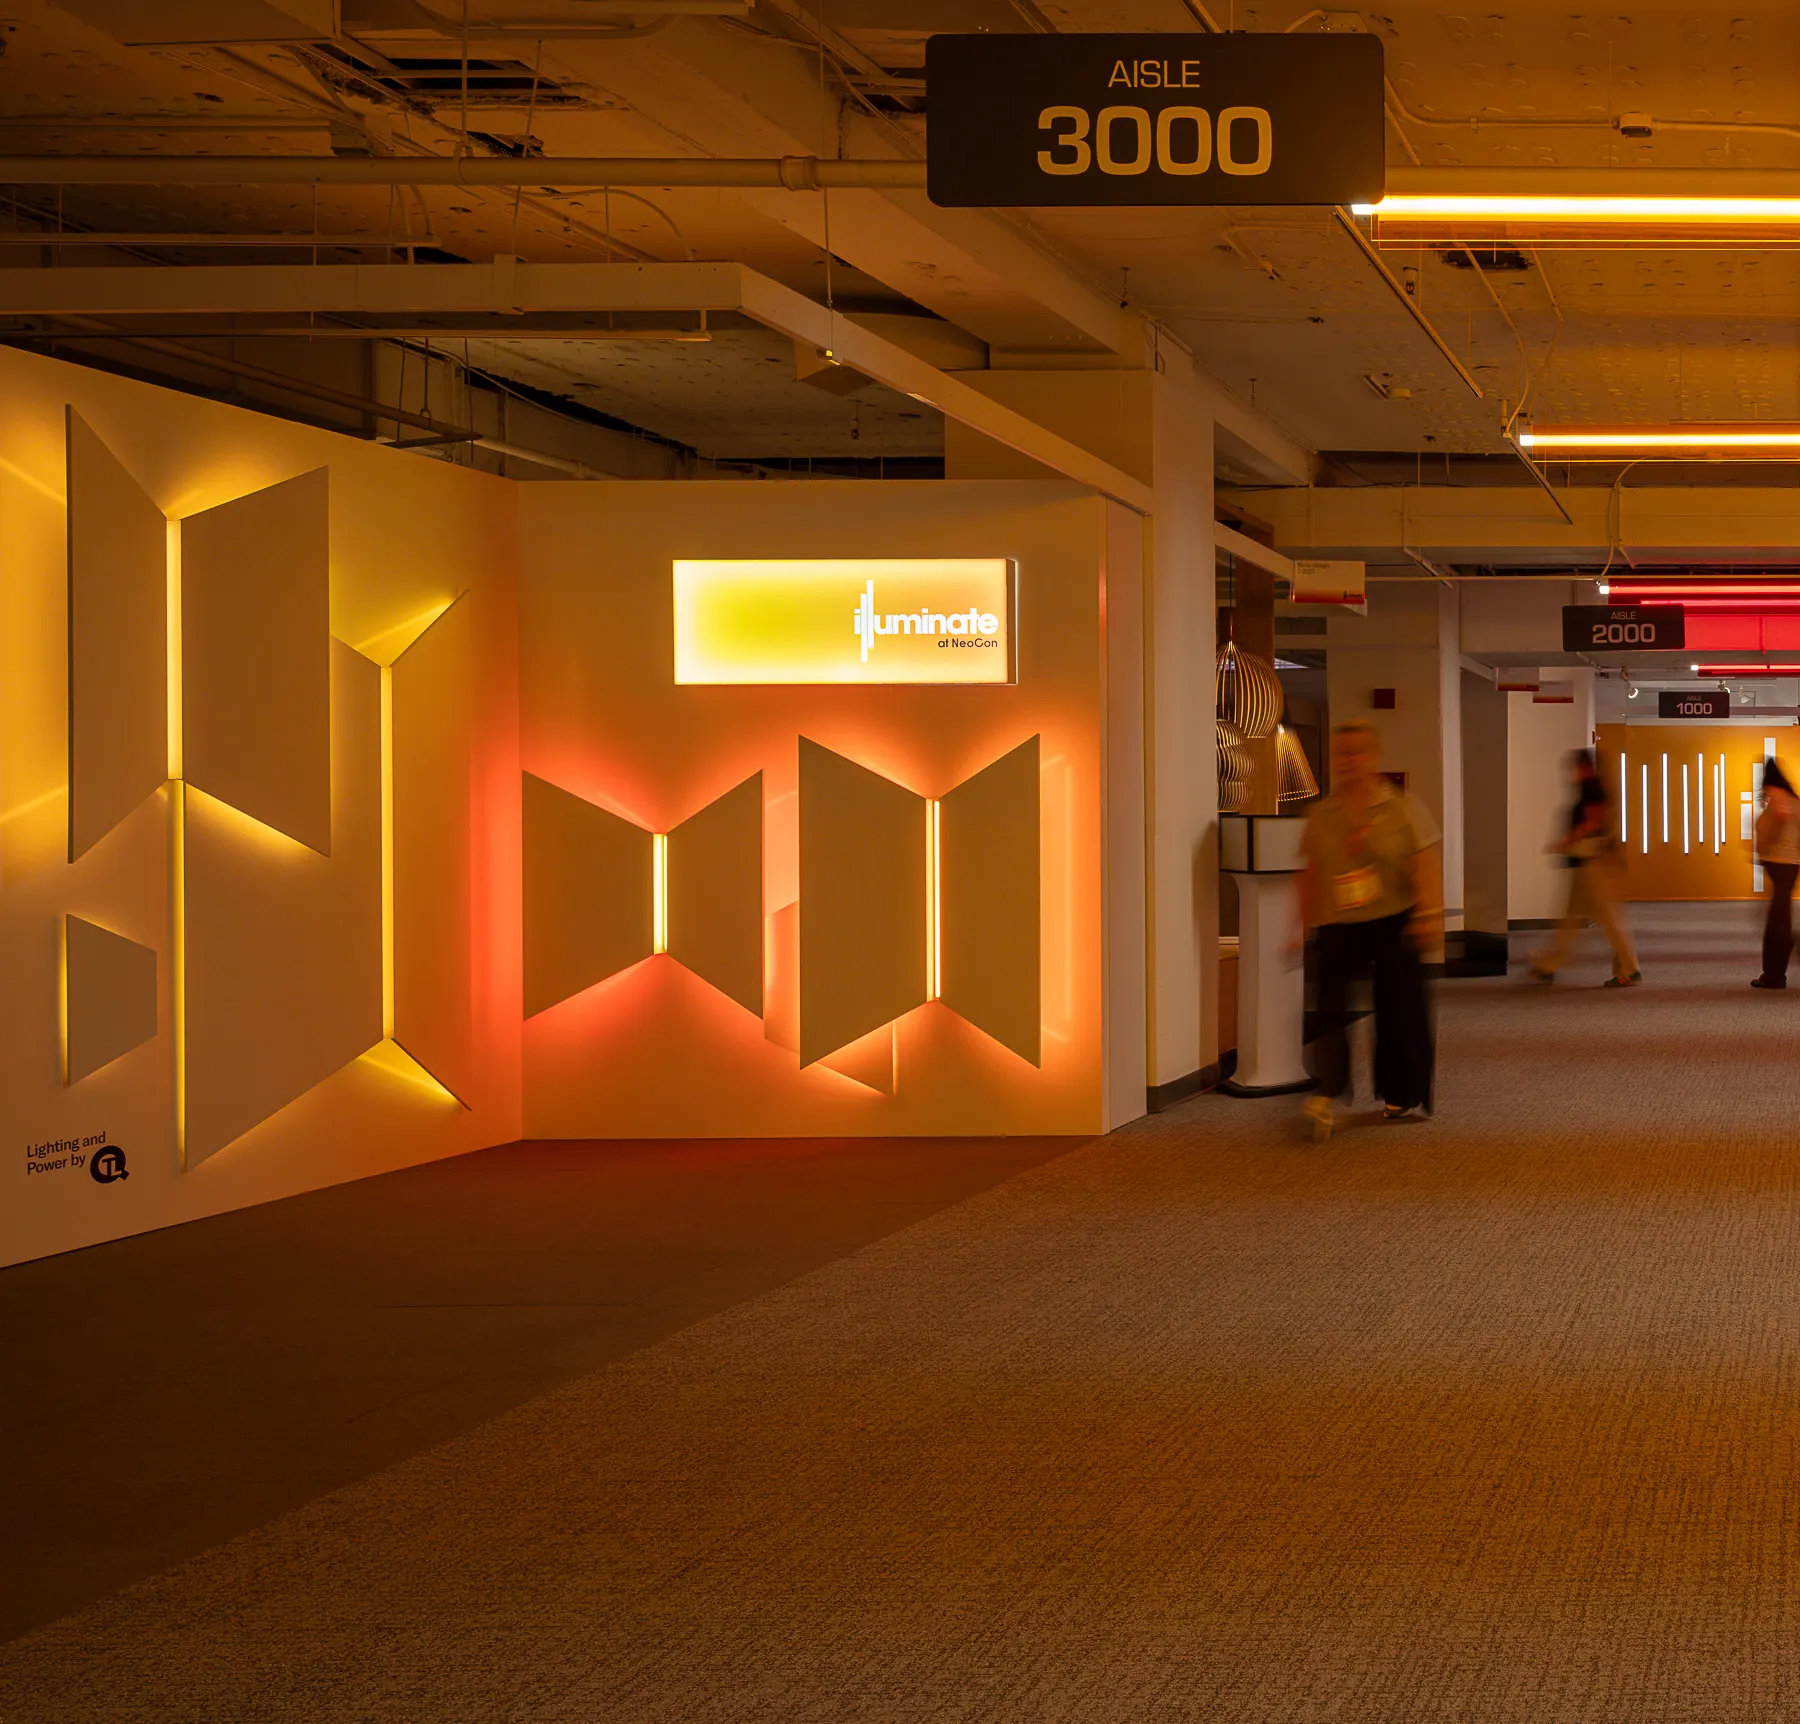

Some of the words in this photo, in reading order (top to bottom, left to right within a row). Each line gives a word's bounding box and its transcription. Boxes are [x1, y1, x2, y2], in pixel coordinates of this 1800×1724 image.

[1108, 60, 1200, 88] AISLE
[1037, 105, 1273, 176] 3000
[853, 579, 999, 663] illuminate
[1610, 611, 1637, 620] AISLE
[937, 638, 949, 648] at
[951, 638, 998, 648] NeoCon
[1592, 623, 1656, 644] 2000
[1676, 702, 1712, 715] 1000
[27, 1137, 80, 1159] Lighting
[82, 1131, 106, 1148] and
[27, 1157, 68, 1175] Power
[71, 1154, 86, 1168] by
